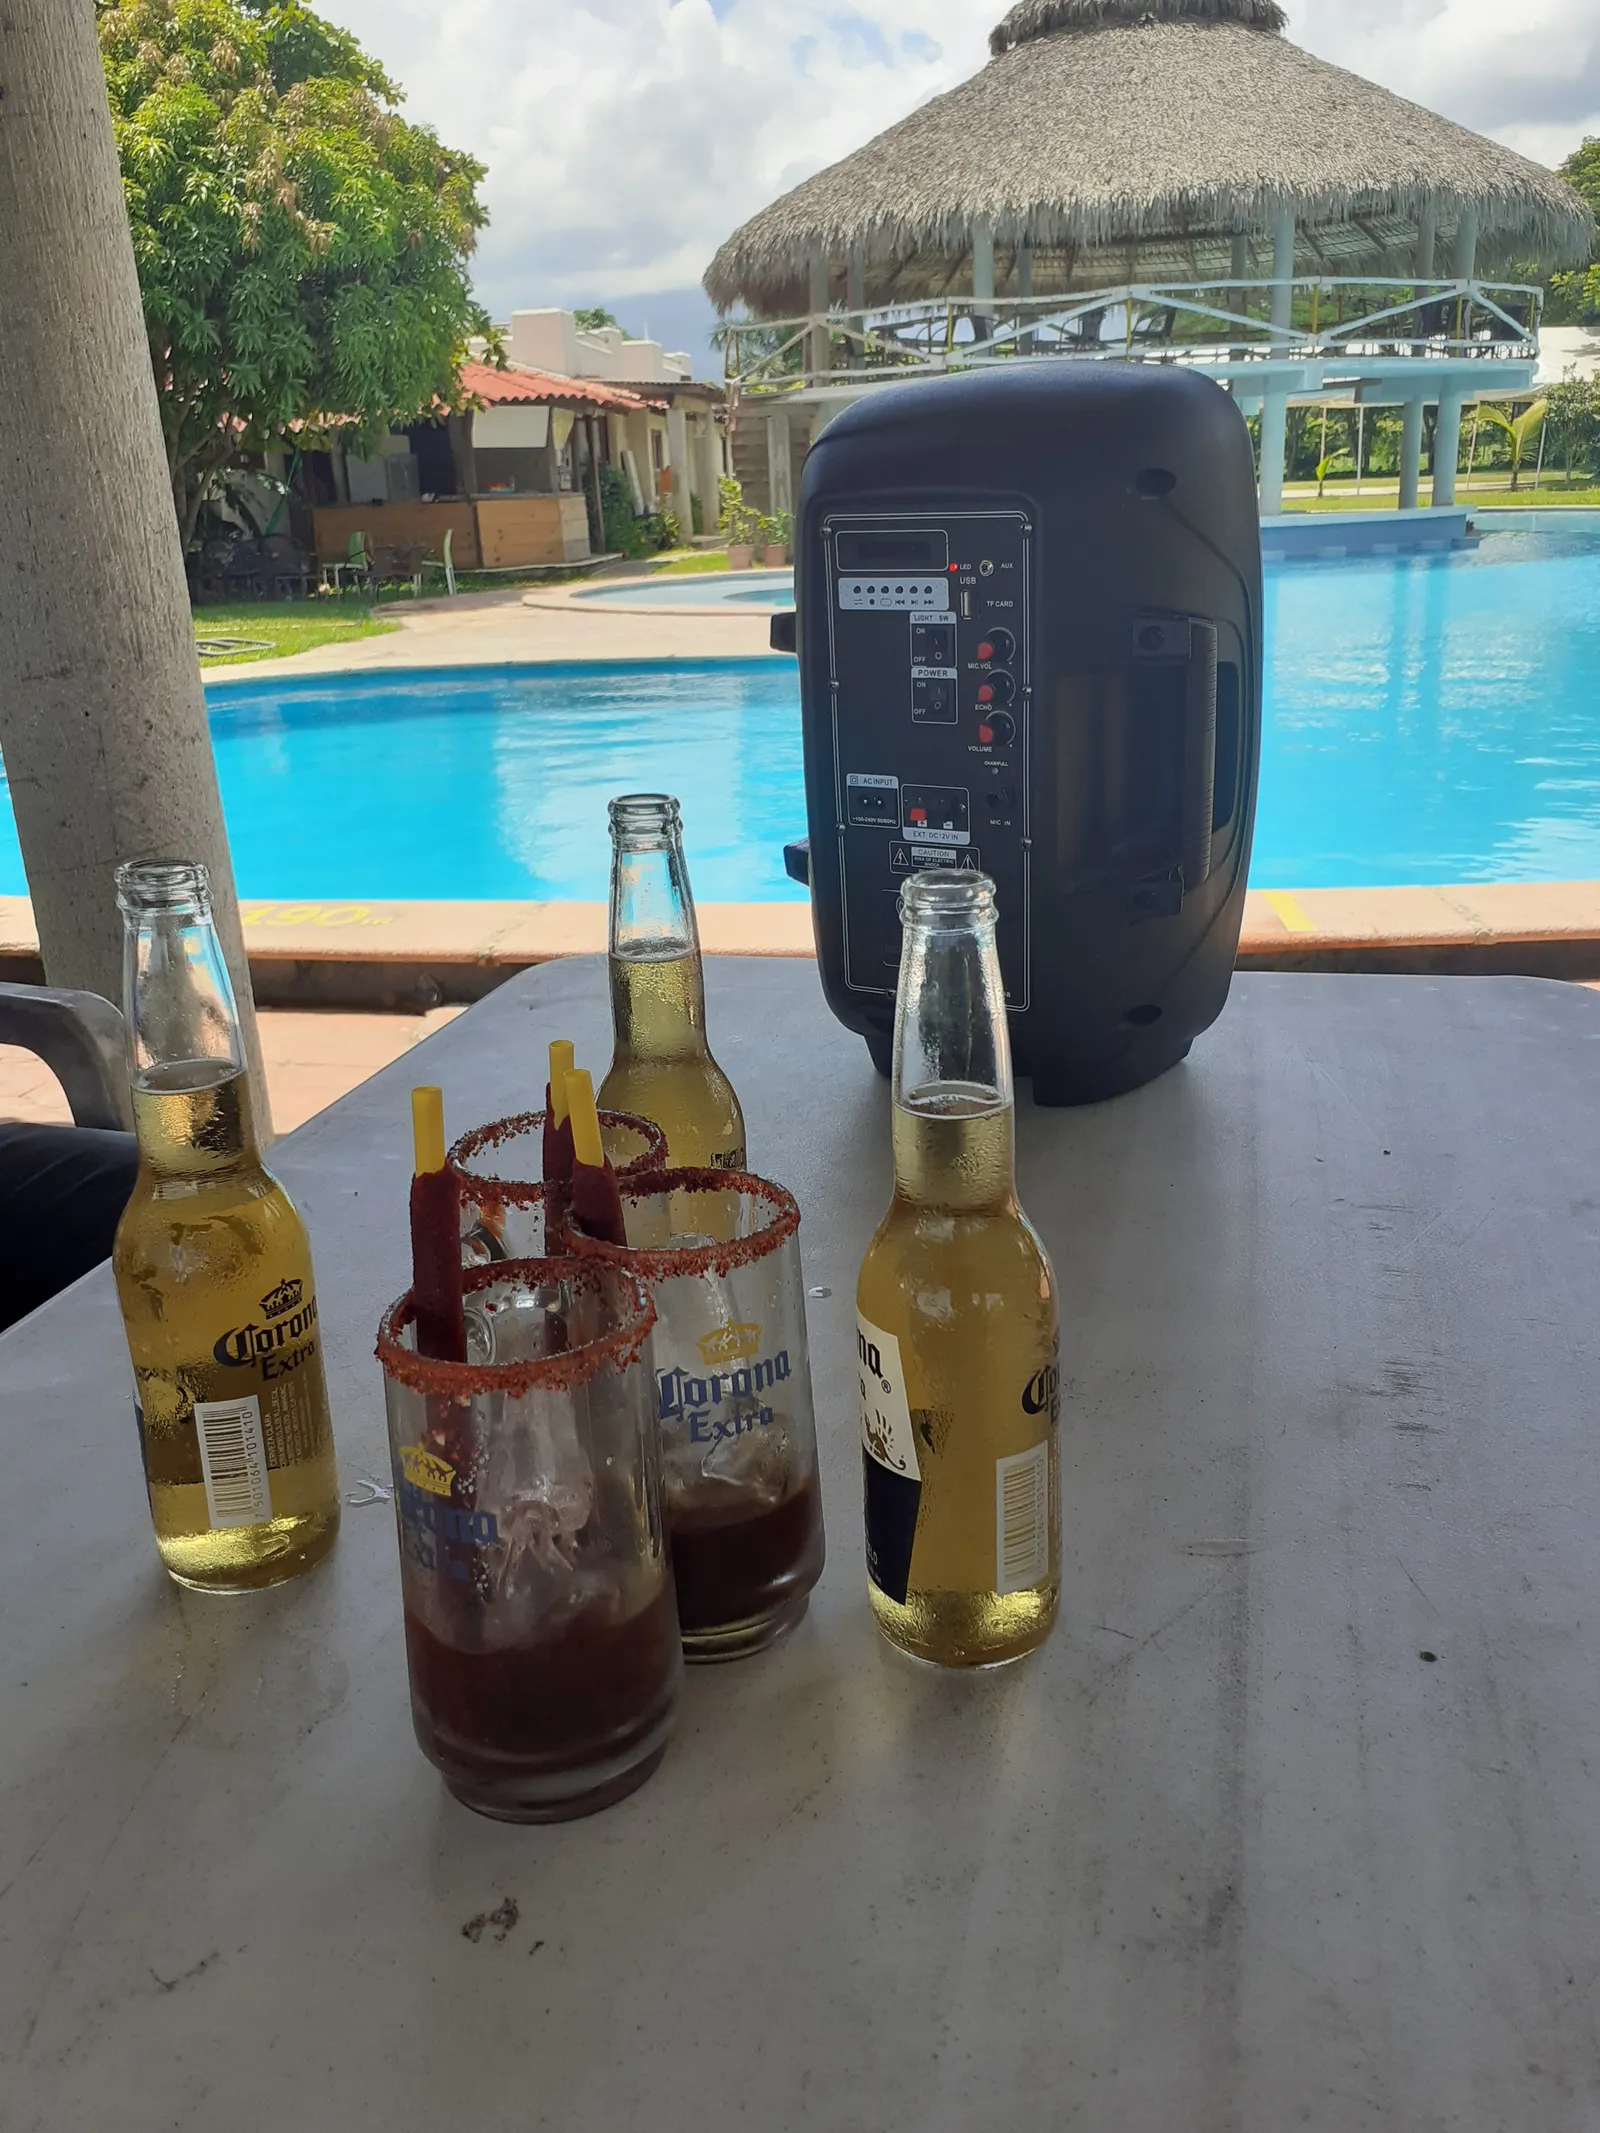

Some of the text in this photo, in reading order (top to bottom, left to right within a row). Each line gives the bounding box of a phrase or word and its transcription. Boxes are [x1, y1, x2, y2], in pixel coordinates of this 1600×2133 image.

[960, 576, 977, 585] USB
[995, 600, 1014, 608] CARD
[914, 614, 949, 622] LIGHT SW
[918, 669, 948, 677] POWER
[967, 745, 993, 753] VOLUME
[863, 777, 894, 786] AC INPUT
[913, 830, 925, 838] EXT
[917, 848, 950, 857] CAUTION
[932, 857, 954, 865] ELECTRIC
[213, 1294, 318, 1368] Corona
[262, 1339, 315, 1382] Extra
[656, 1350, 792, 1423] Corona
[688, 1407, 774, 1444] Extra
